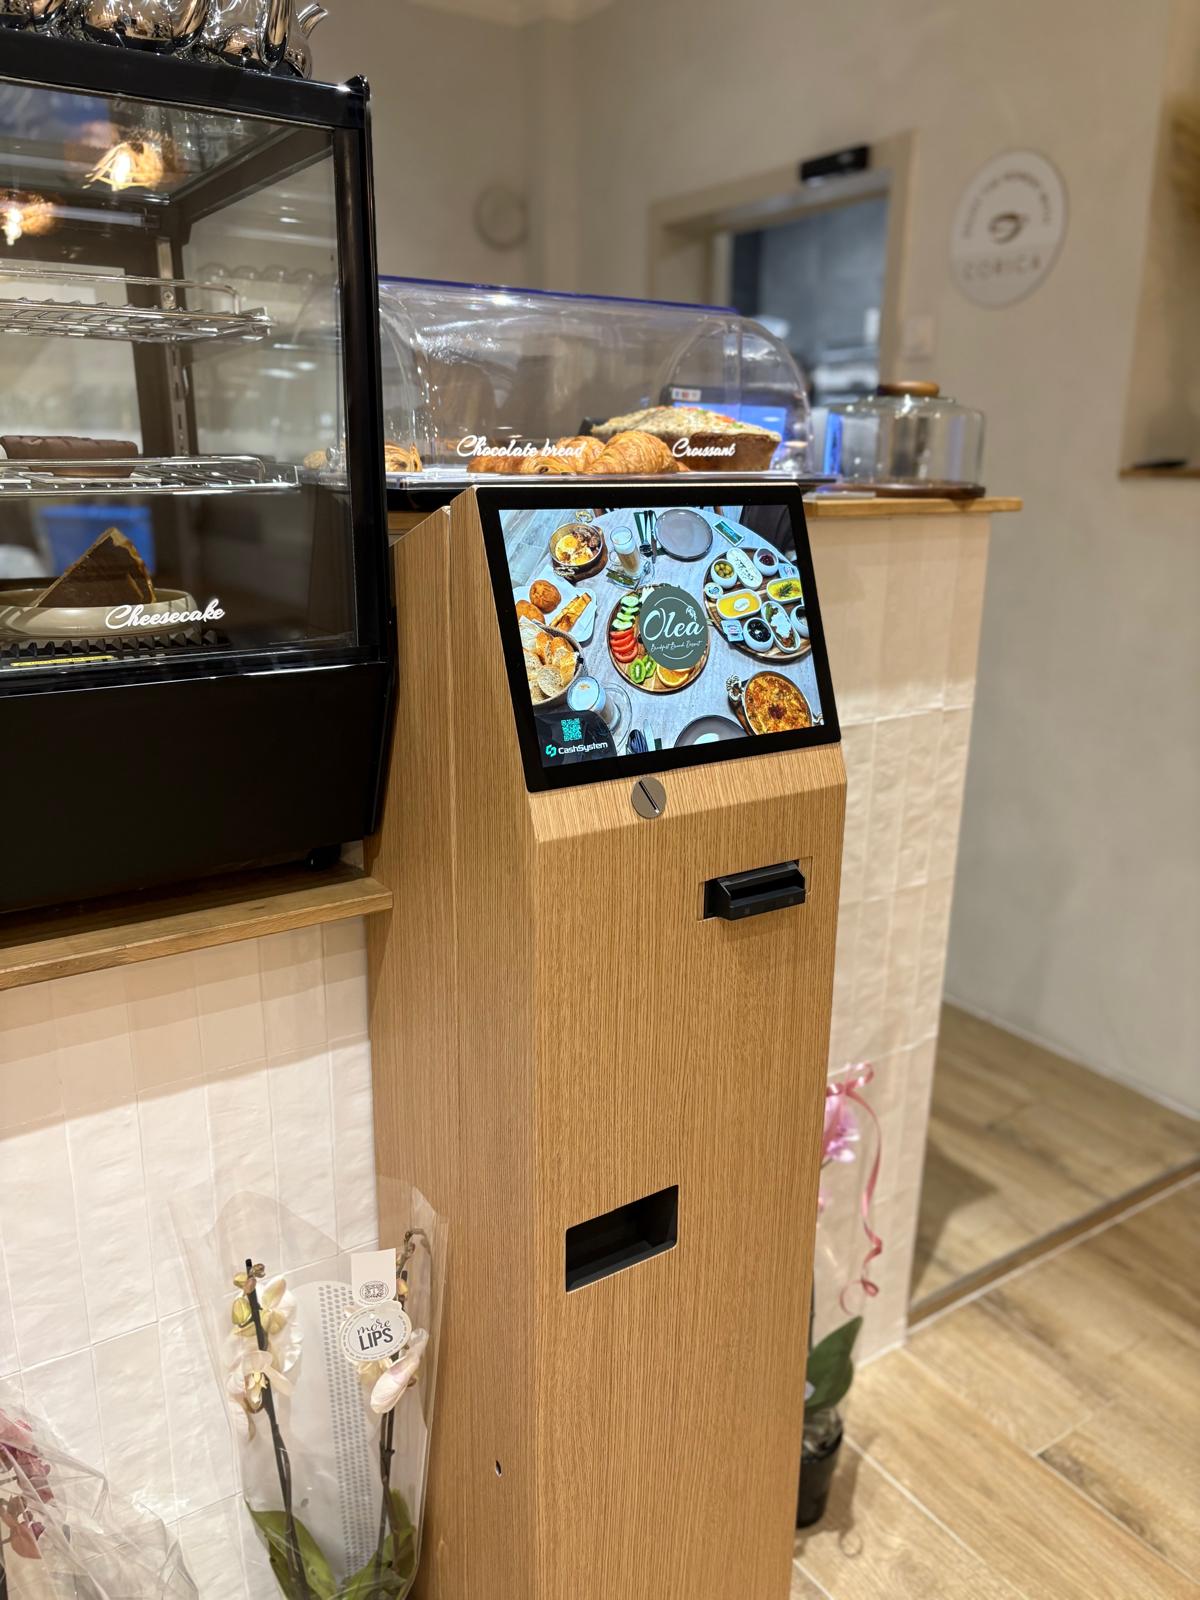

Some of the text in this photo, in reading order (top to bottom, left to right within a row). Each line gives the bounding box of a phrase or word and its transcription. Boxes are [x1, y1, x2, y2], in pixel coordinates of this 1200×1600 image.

[456, 435, 587, 457] Chocolate bread
[672, 438, 736, 458] Croissant
[105, 598, 225, 629] Cheesecake
[558, 742, 608, 754] CashSystem
[356, 1318, 391, 1336] more
[358, 1327, 394, 1351] LIPS
